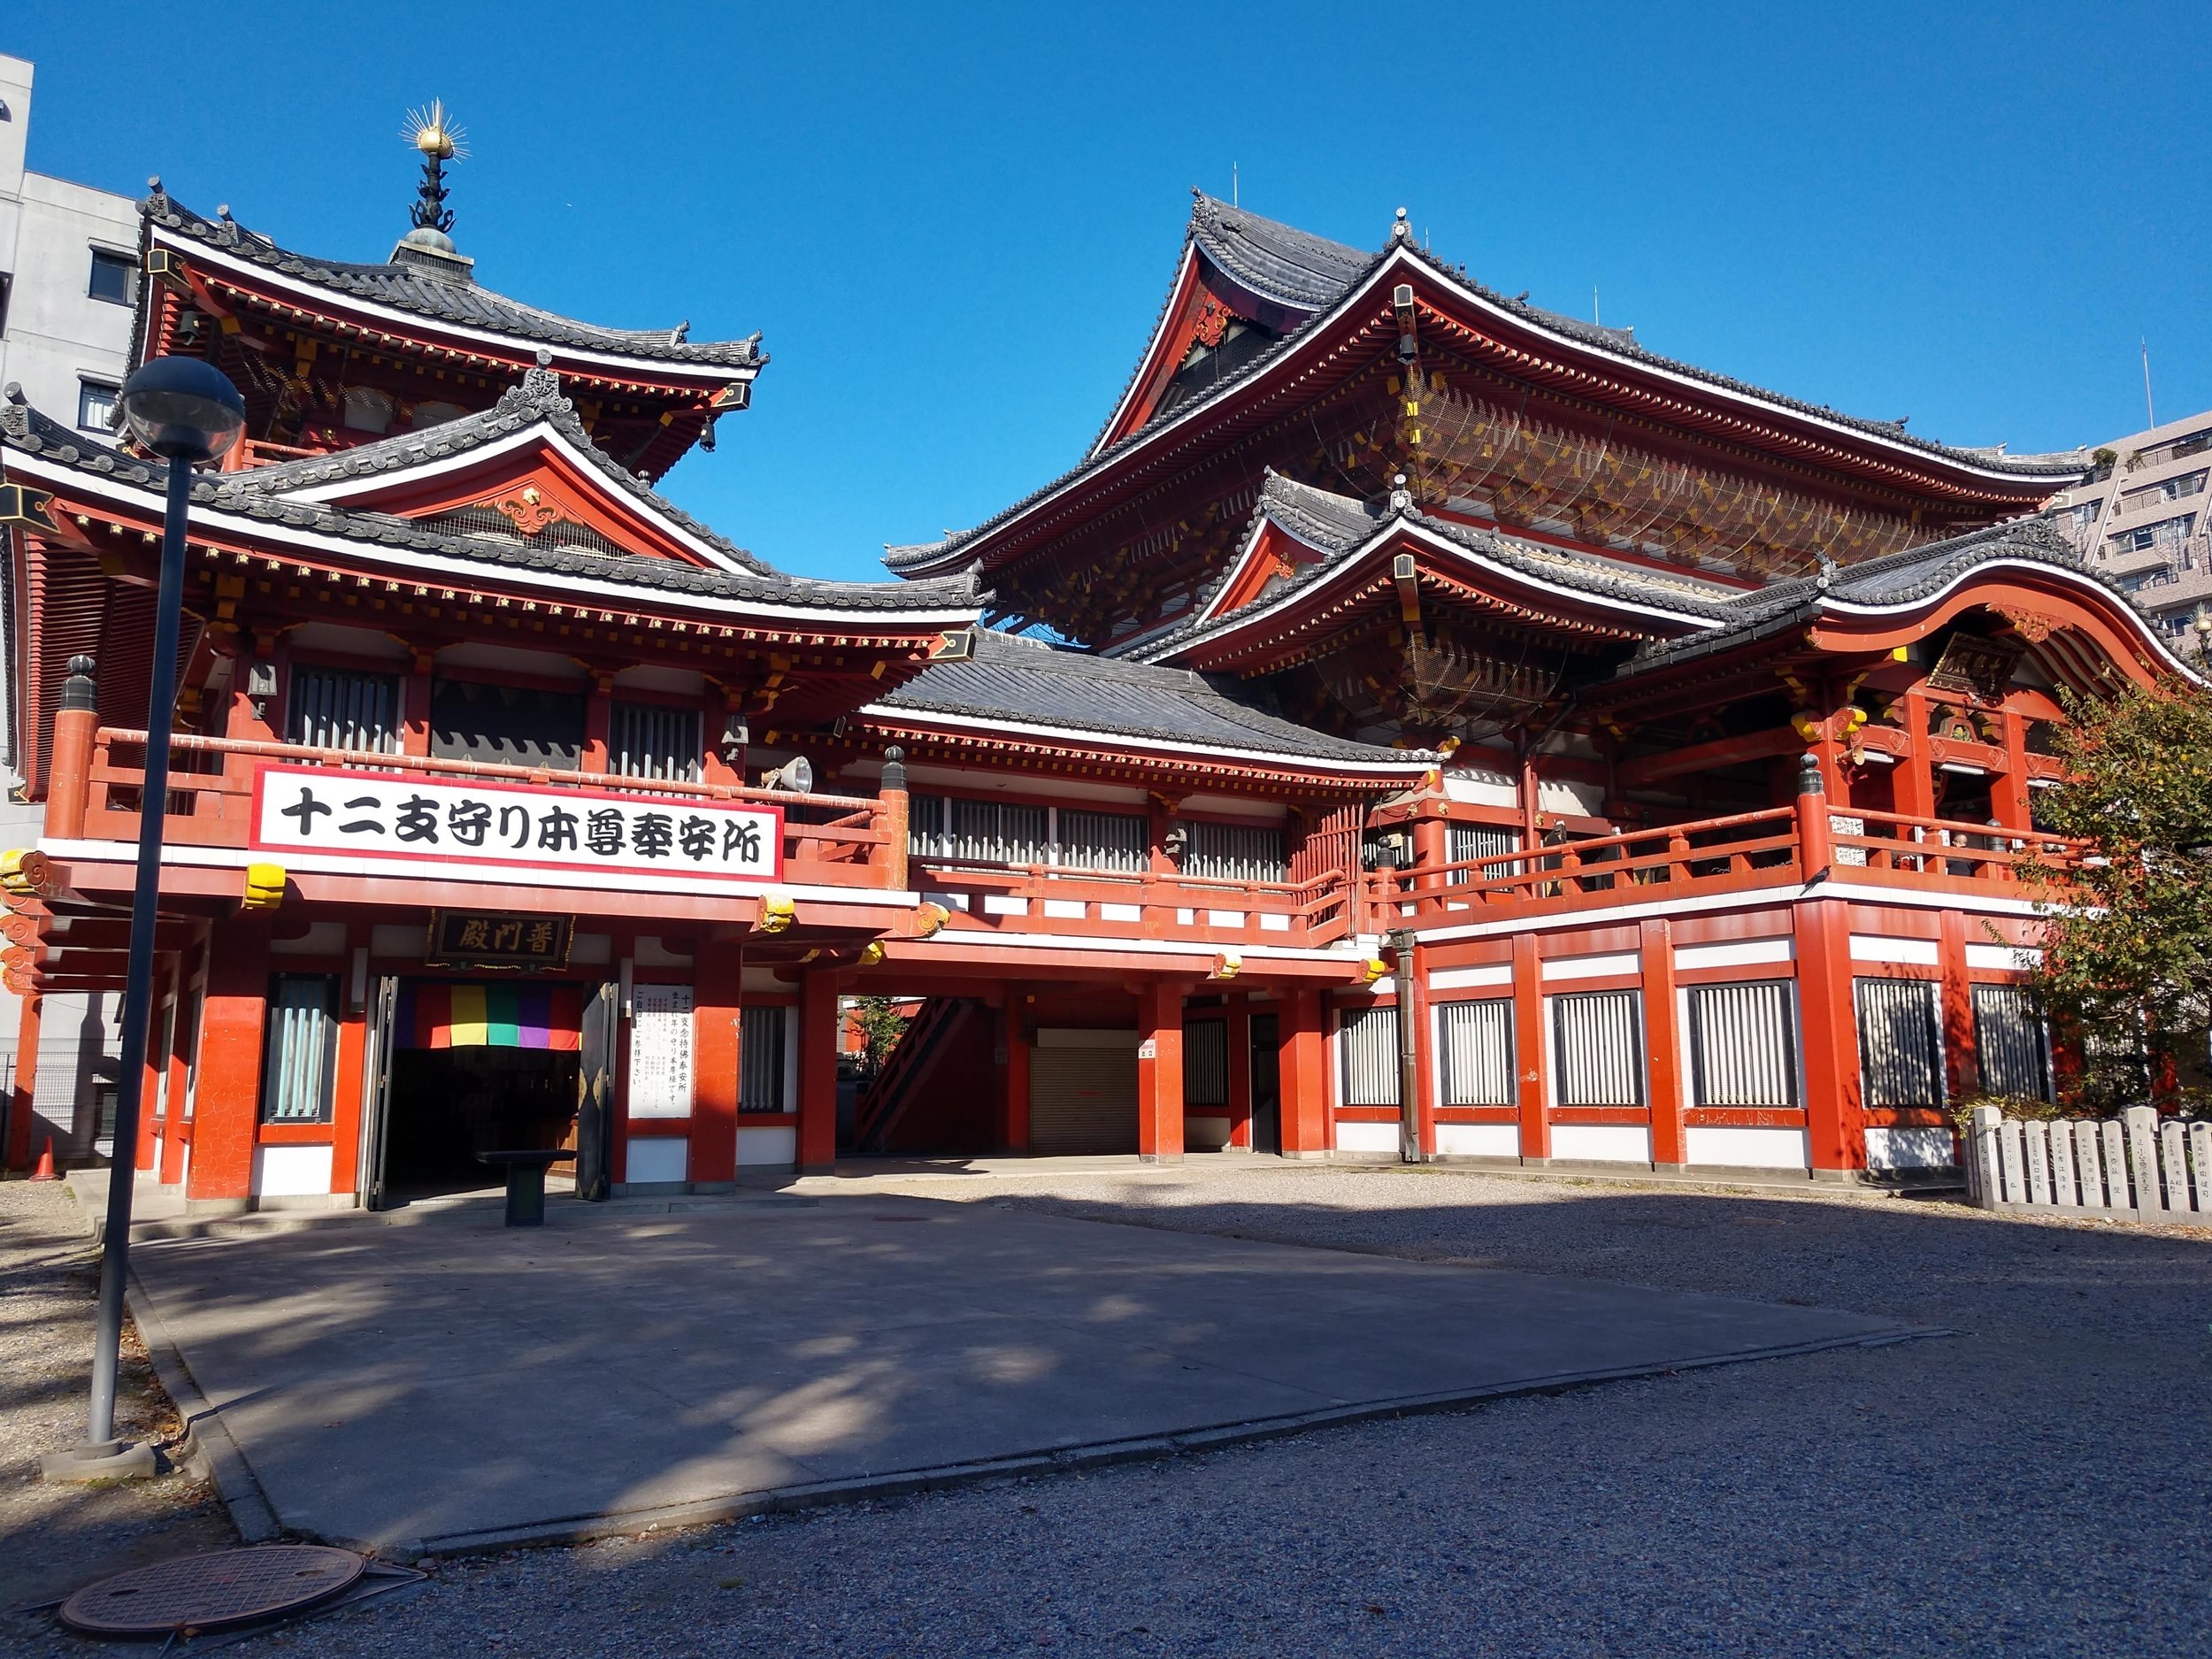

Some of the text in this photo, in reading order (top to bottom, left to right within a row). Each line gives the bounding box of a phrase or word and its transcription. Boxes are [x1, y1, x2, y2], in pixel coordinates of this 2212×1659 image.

[280, 786, 761, 864] 十二支守り本尊奉安所
[457, 918, 554, 954] 普門殿
